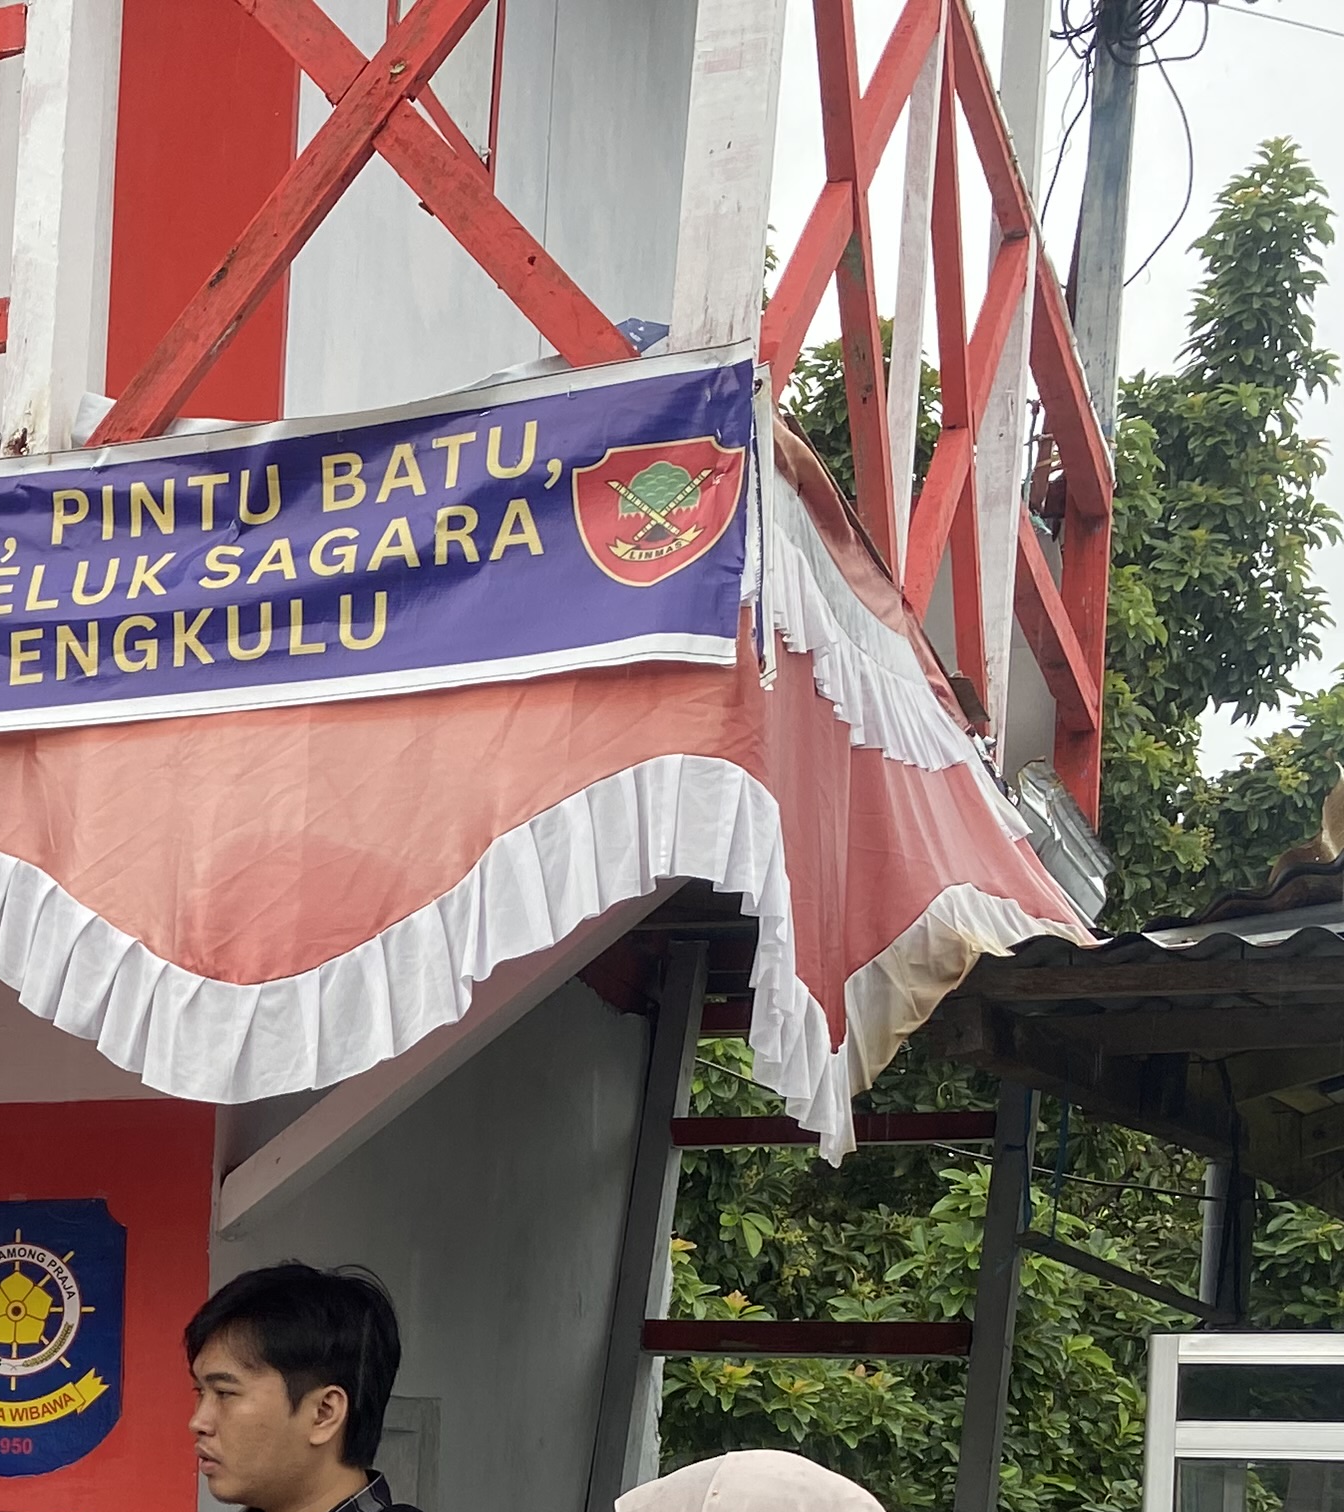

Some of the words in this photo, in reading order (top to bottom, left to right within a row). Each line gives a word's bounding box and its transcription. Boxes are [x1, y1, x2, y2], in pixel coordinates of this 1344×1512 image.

[52, 462, 283, 551] PINTU
[321, 418, 565, 511] BATU,
[199, 497, 546, 588] SAGARA
[629, 541, 682, 560] LINMAS
[46, 1258, 77, 1301] PRAJA
[8, 1392, 75, 1422] WIBAWA
